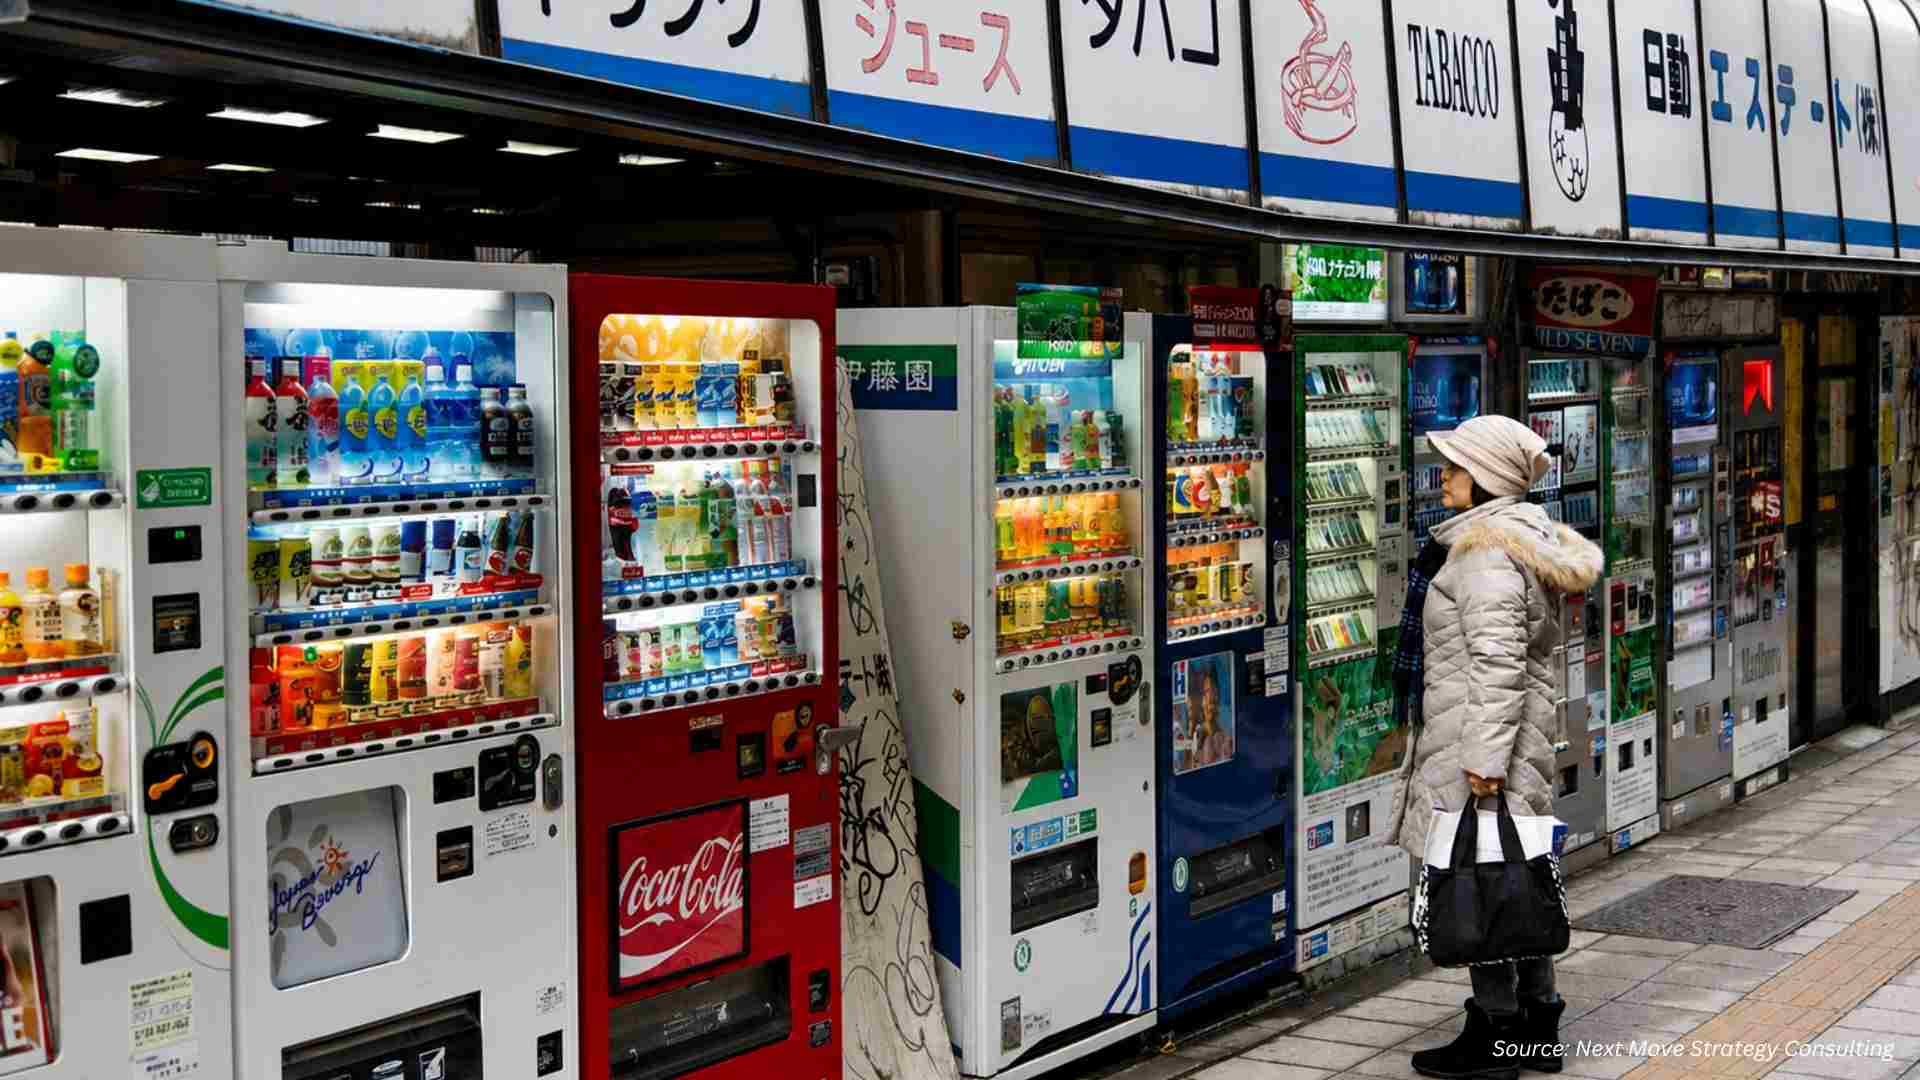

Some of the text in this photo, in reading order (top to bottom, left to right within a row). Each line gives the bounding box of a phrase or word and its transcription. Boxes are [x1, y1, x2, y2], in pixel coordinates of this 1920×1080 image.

[1407, 23, 1499, 119] TABACCO
[1541, 280, 1621, 319] たばこ
[1574, 331, 1634, 351] SEVEN
